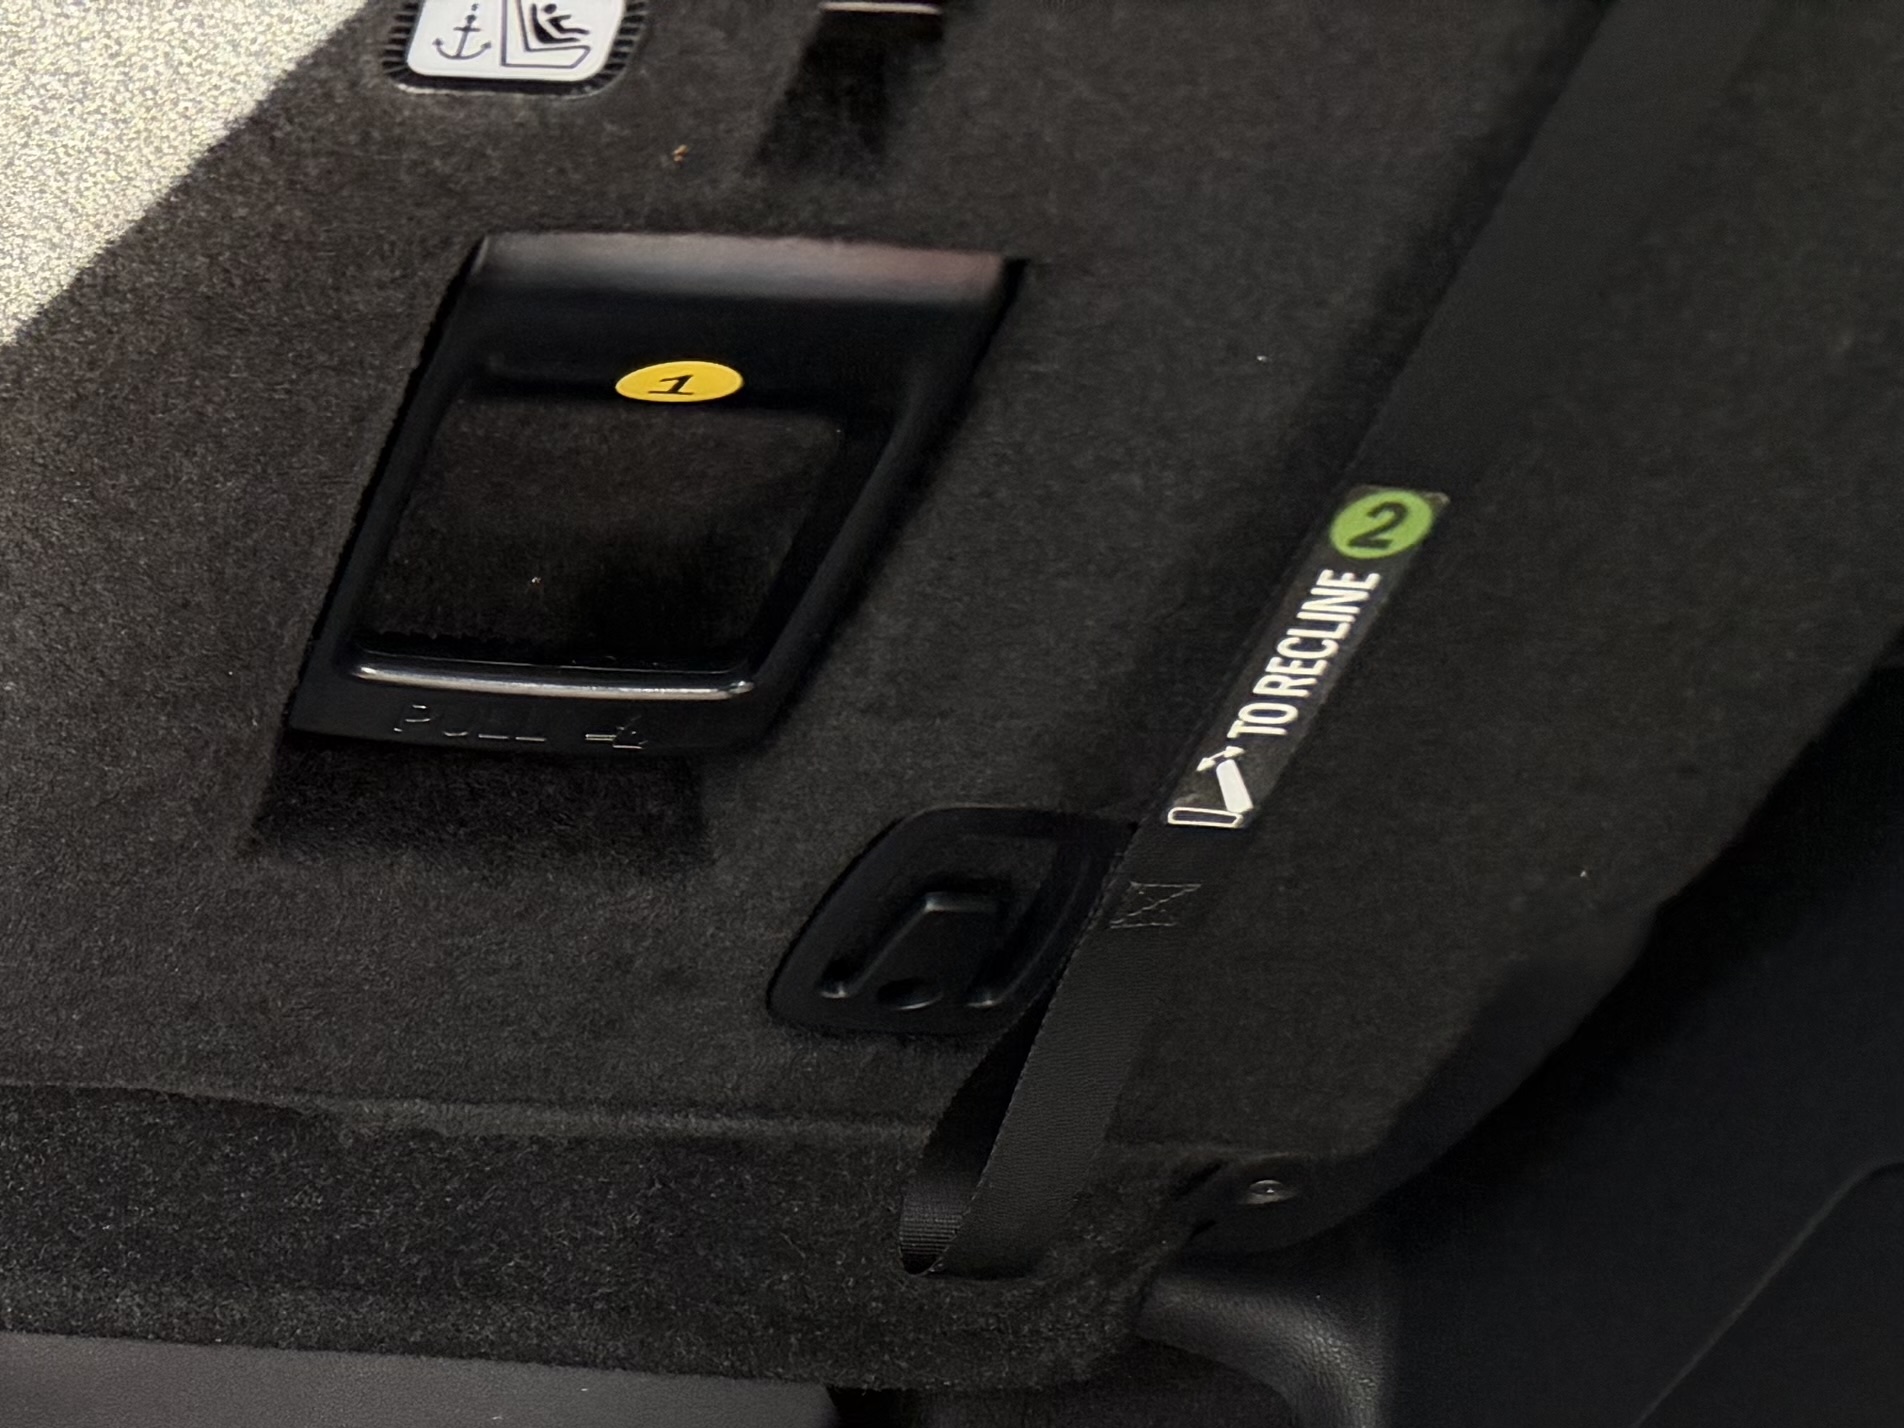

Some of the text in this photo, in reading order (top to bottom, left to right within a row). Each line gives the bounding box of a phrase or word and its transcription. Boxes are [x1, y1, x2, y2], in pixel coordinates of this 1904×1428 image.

[647, 374, 698, 397] 1
[1347, 502, 1410, 549] 2
[1227, 569, 1382, 738] TO RECLINE
